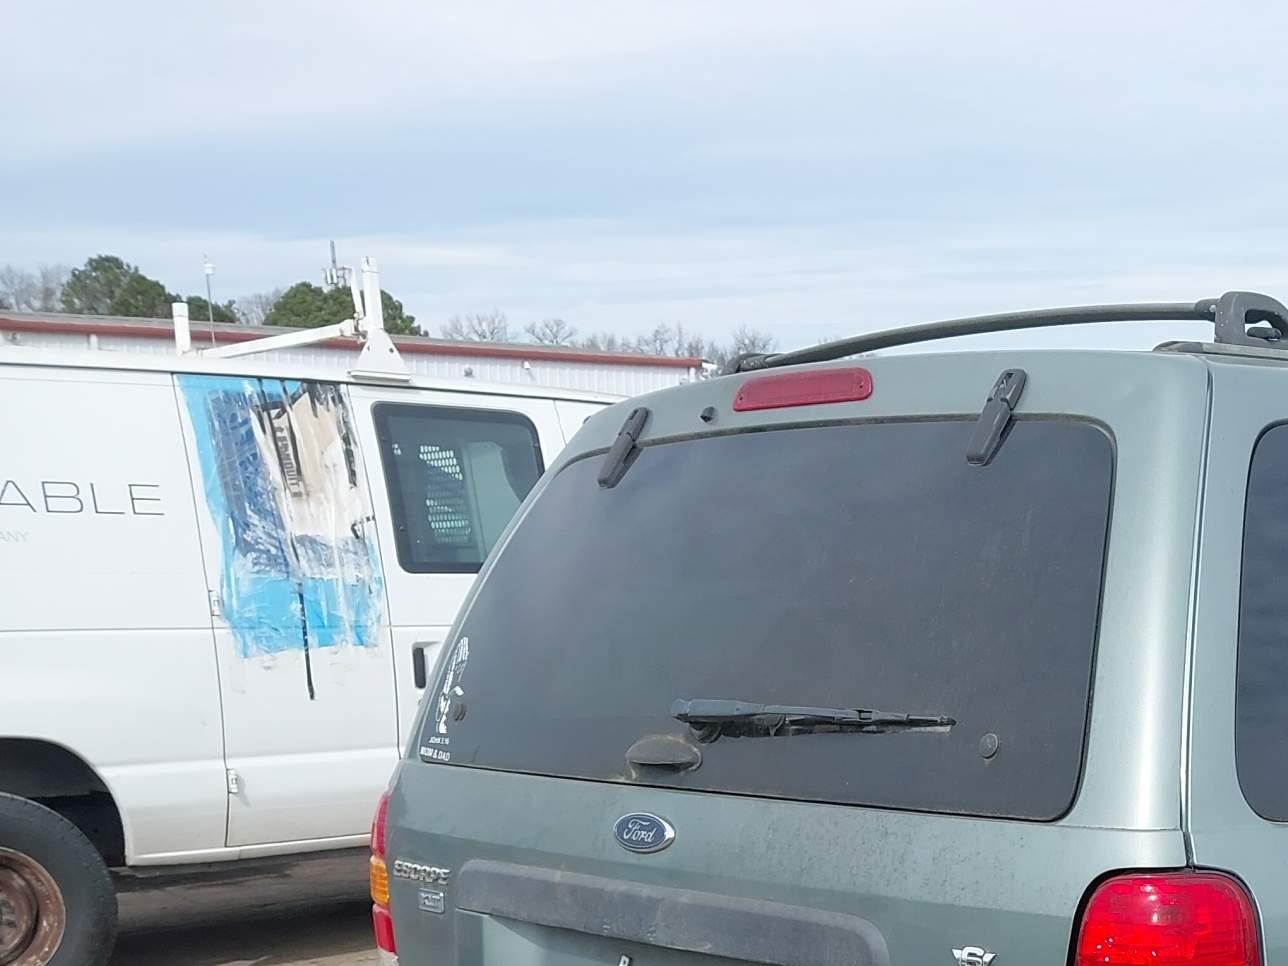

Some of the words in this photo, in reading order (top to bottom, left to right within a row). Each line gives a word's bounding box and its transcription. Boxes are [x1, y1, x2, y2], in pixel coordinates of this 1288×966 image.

[0, 480, 165, 516] ABLE
[438, 750, 451, 761] DAD
[623, 819, 657, 842] Ford
[393, 860, 451, 885] ESCAPE
